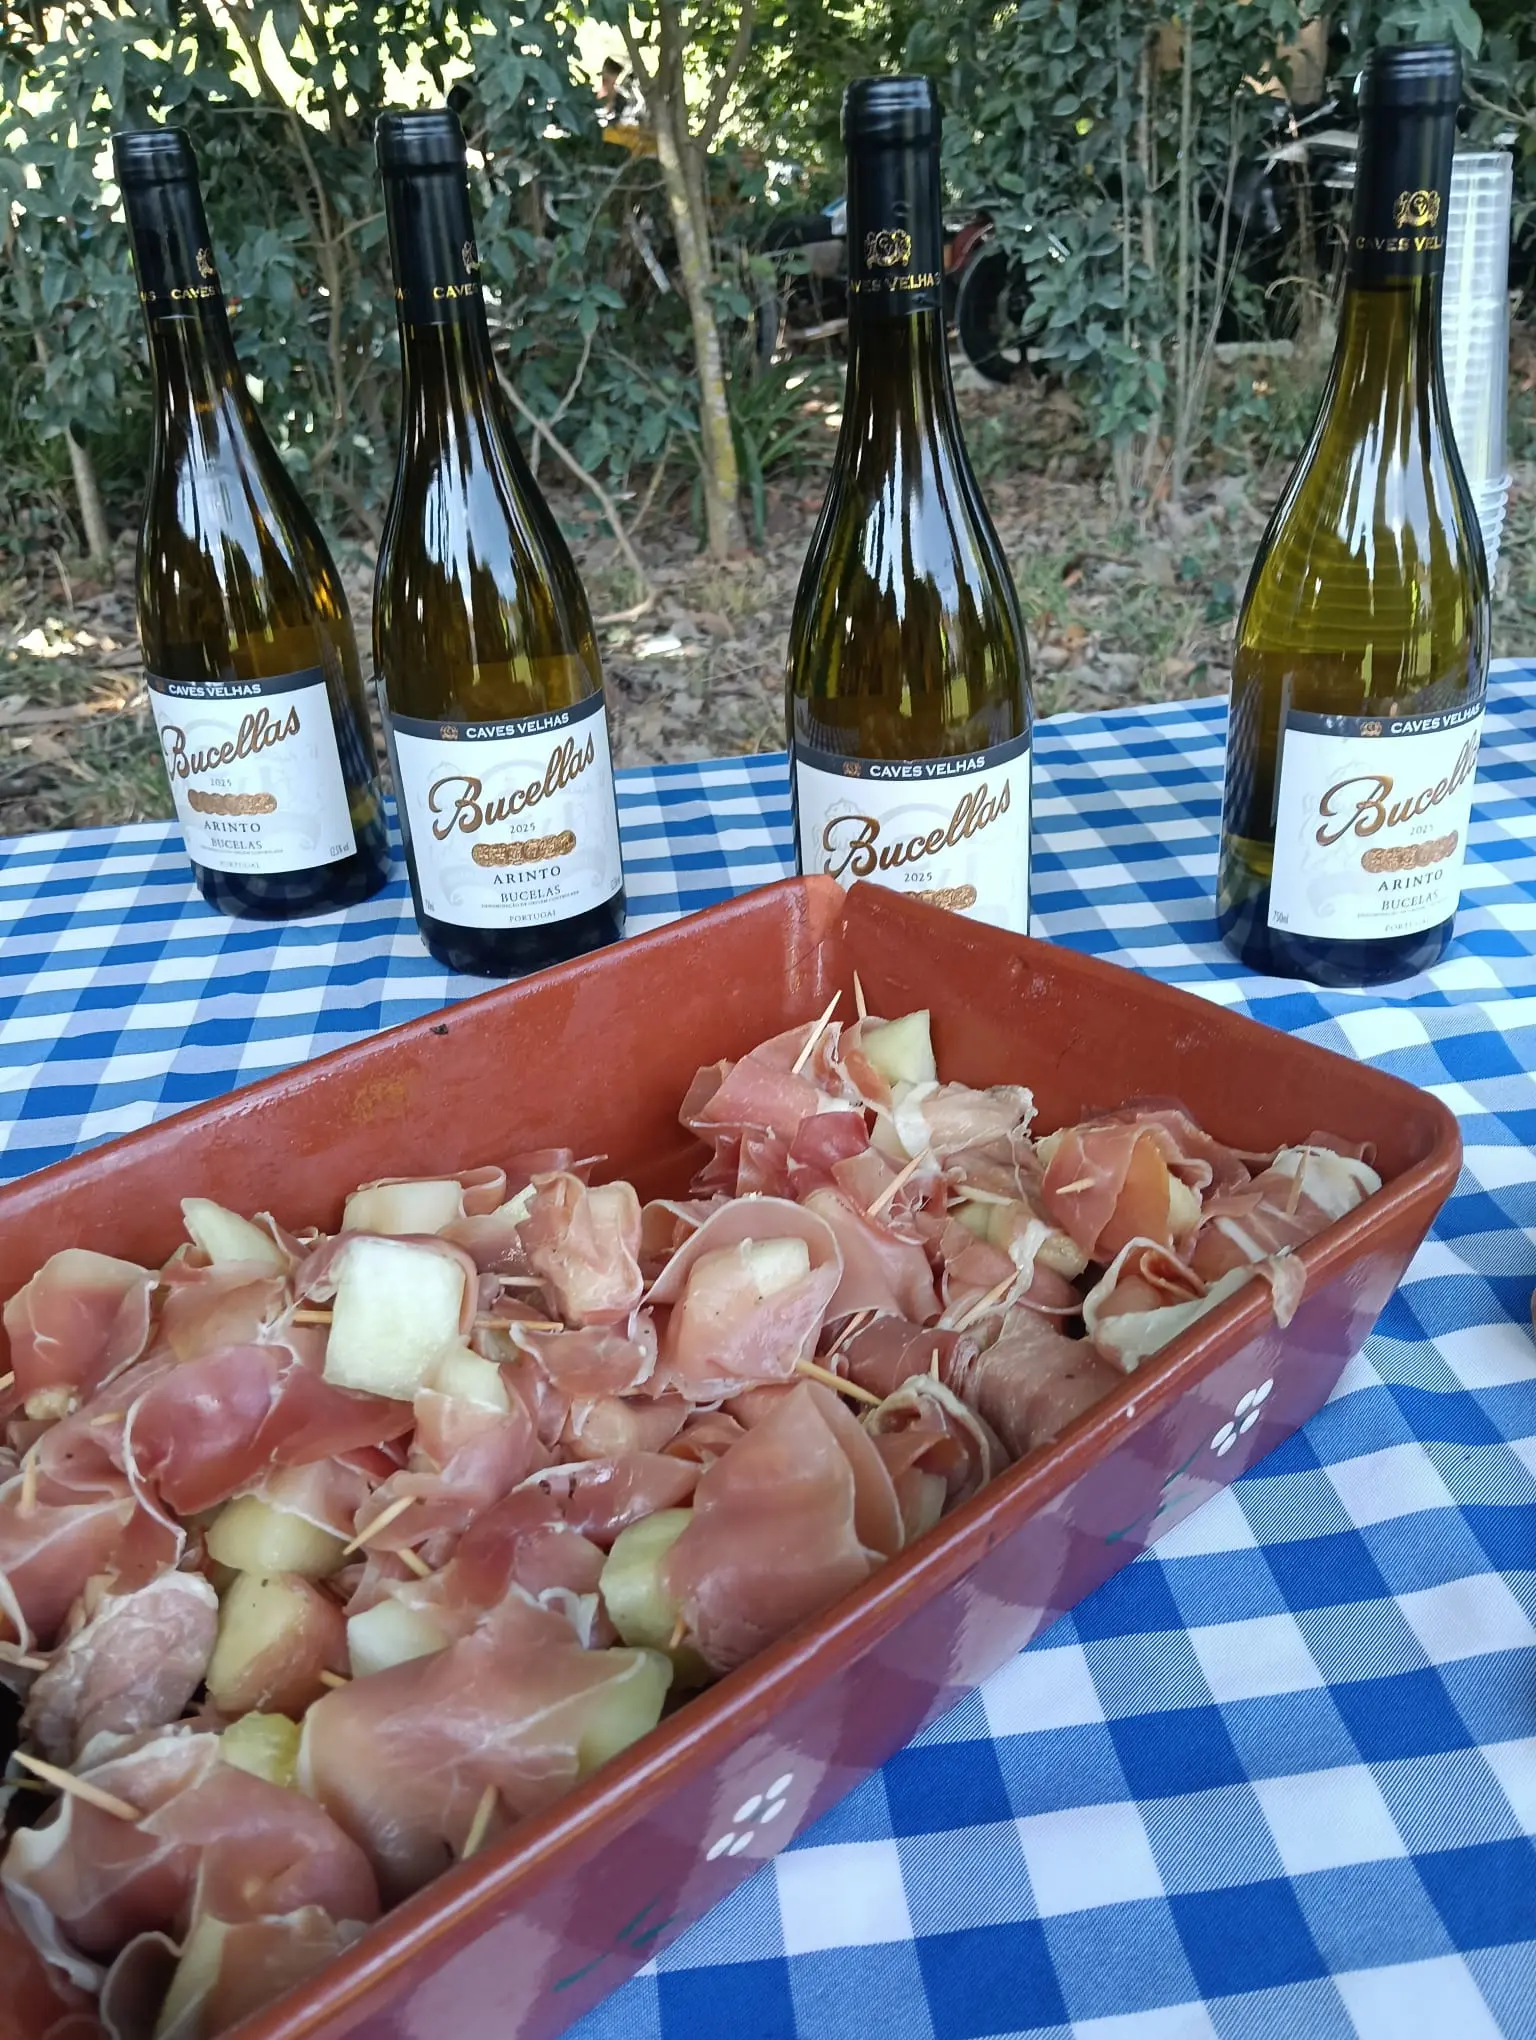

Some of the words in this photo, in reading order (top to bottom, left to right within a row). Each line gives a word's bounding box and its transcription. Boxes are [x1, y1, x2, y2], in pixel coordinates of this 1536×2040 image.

[168, 683, 205, 697] CAVES
[206, 683, 262, 697] VELHAS
[465, 725, 515, 739] CAVES
[517, 712, 570, 735] VELHAS
[1390, 717, 1440, 734] CAVES
[1442, 703, 1481, 727] VELHAS
[160, 705, 301, 781] Bucellas
[869, 765, 922, 778] CAVES
[925, 756, 986, 776] VELHAS
[428, 732, 595, 841] Bucellas
[1315, 728, 1478, 847] Bucell
[203, 820, 261, 833] ARINTO
[509, 822, 536, 834] 2025
[822, 778, 1011, 880] Bucellas
[211, 837, 263, 850] BUCELAS
[493, 865, 561, 885] ARINTO
[903, 872, 933, 882] 2025
[1377, 869, 1443, 892] ARINTO
[500, 884, 561, 903] BUCELAS
[1381, 889, 1439, 911] BUCELAS
